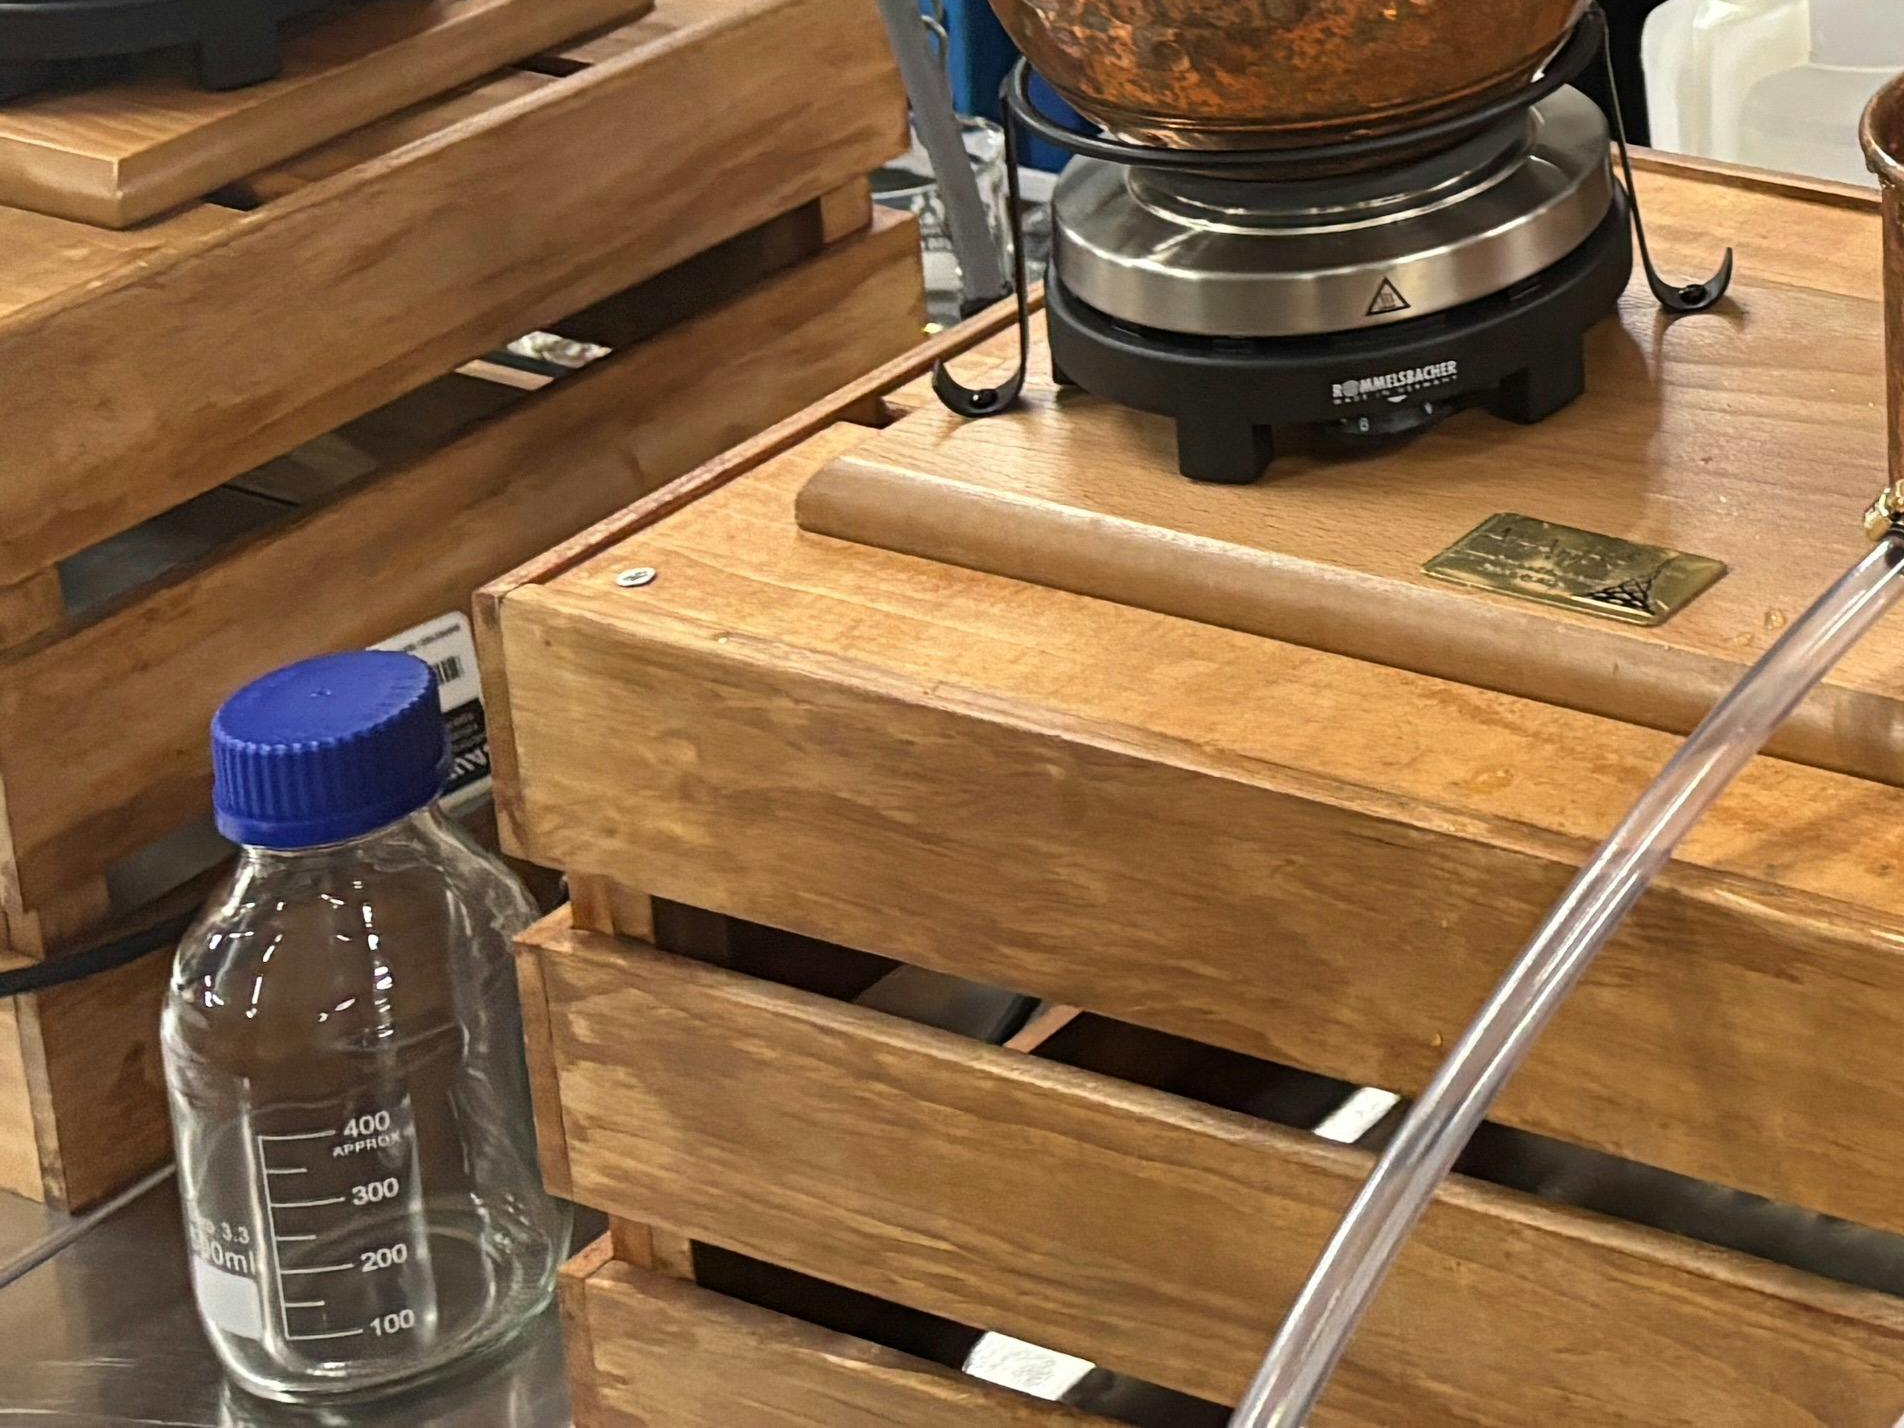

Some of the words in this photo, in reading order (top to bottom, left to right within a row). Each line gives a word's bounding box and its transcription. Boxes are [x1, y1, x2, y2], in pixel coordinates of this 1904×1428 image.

[344, 1110, 391, 1138] 400
[332, 1130, 402, 1157] APPROX
[352, 1177, 400, 1206] 300
[221, 1221, 250, 1245] 3.3
[361, 1243, 408, 1273] 200
[370, 1309, 415, 1337] 100
